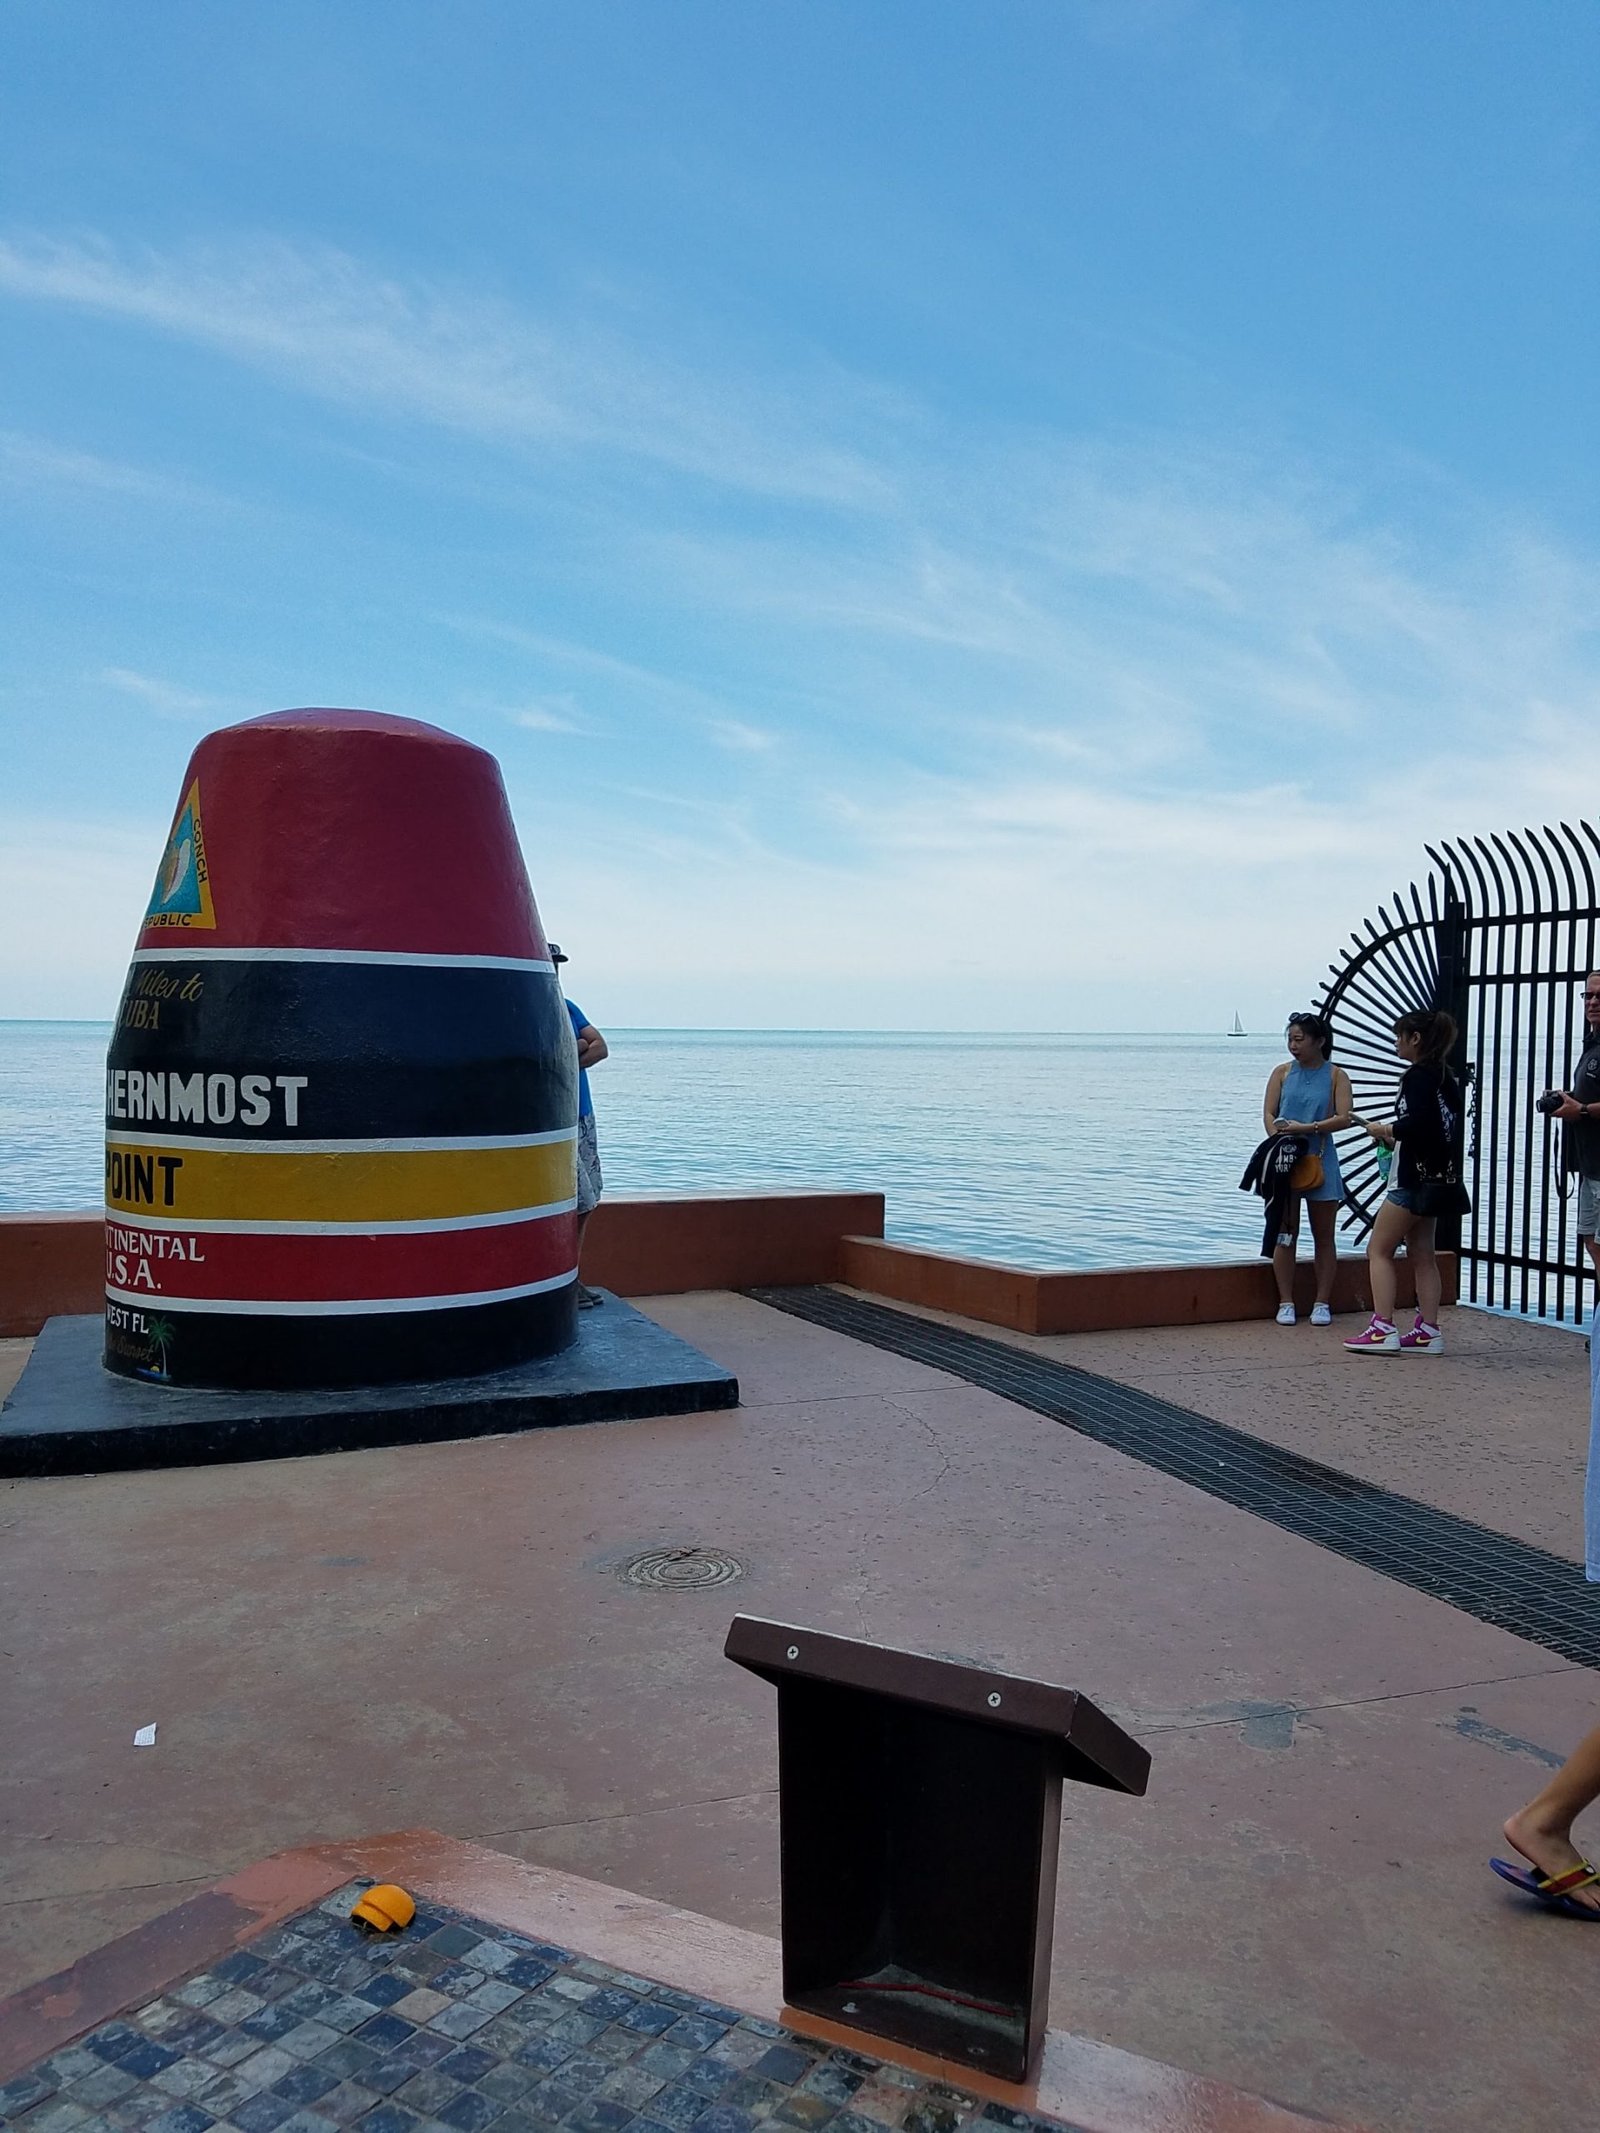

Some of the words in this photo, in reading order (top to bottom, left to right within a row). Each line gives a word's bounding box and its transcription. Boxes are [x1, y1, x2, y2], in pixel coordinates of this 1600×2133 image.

[193, 818, 207, 884] CONCH
[180, 972, 205, 1002] to
[132, 1312, 150, 1335] FL
